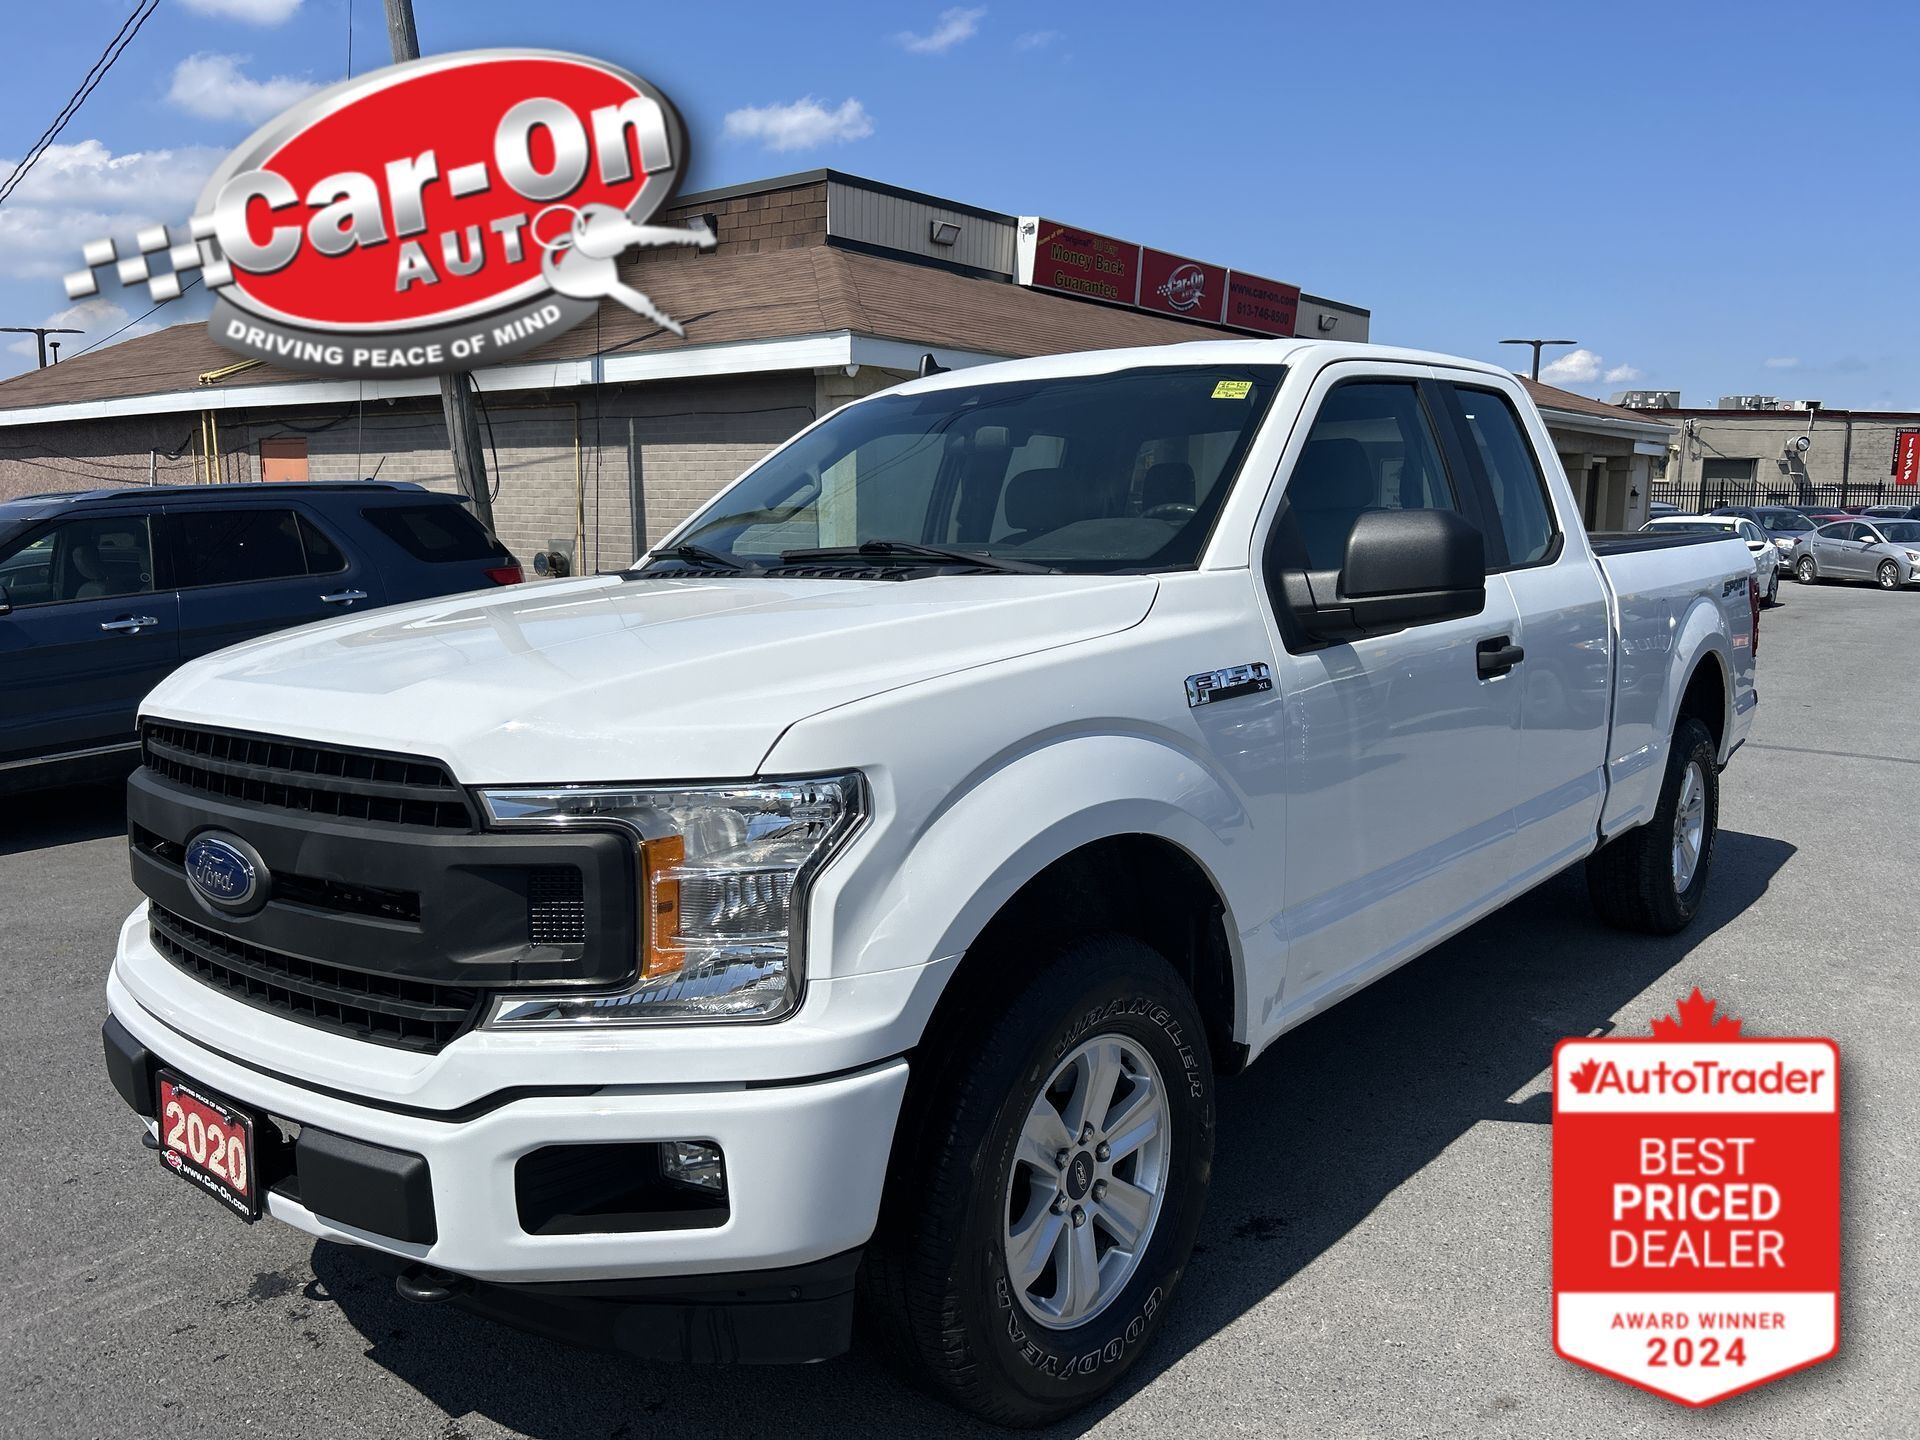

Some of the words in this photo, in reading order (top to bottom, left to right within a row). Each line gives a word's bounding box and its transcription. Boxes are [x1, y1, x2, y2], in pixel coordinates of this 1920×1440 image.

[1051, 243, 1093, 273] Money
[1095, 254, 1125, 277] Back
[1054, 269, 1119, 299] Guarantee
[1230, 282, 1298, 307] www.car-on.com
[1903, 437, 1915, 480] 1638
[1257, 681, 1270, 691] XL
[1054, 997, 1204, 1099] WRANGLER
[165, 1101, 247, 1191] 2020
[182, 1163, 250, 1216] www.Car-On.com
[996, 1274, 1163, 1381] GOODYEAR
